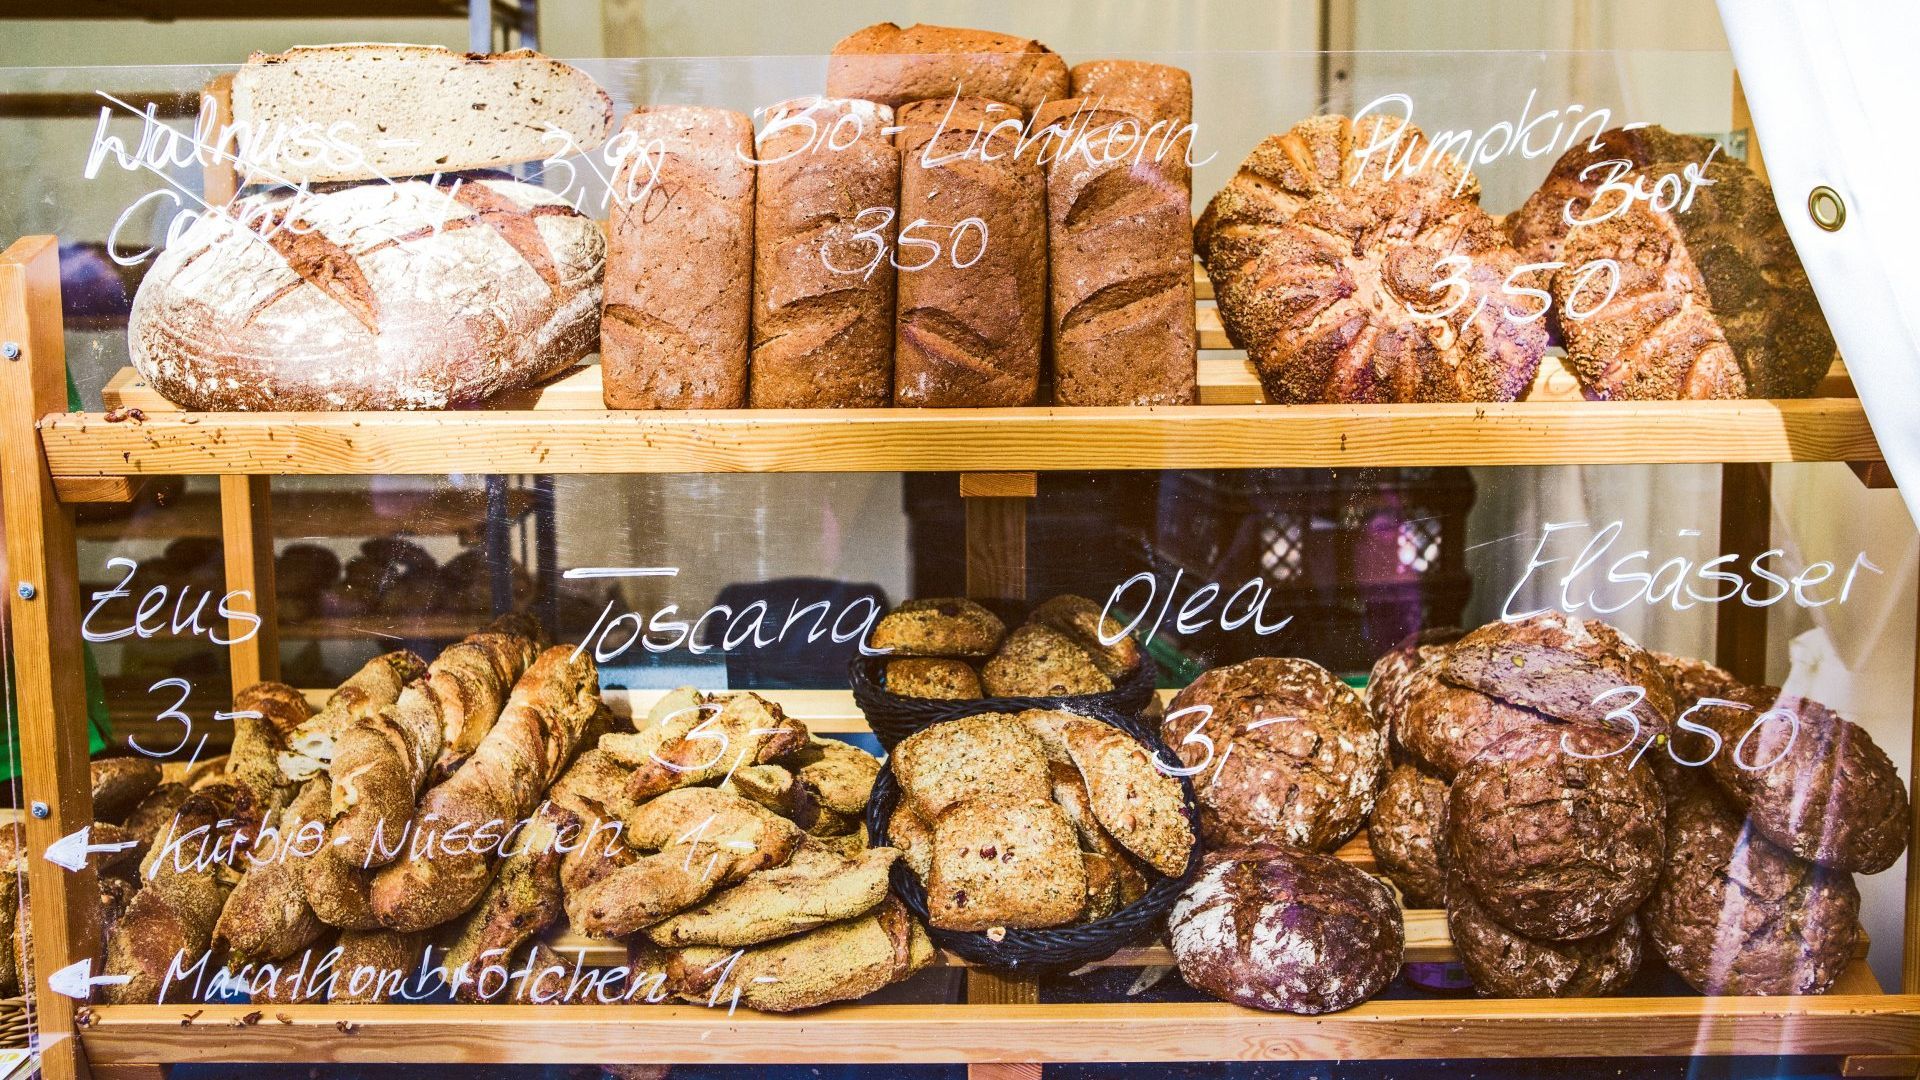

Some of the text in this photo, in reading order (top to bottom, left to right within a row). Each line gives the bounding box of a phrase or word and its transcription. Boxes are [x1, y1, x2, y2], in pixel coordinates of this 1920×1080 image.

[1350, 88, 1650, 197] Pumpkin-
[1563, 141, 1721, 227] Brot
[820, 206, 989, 282] 3,50
[1406, 255, 1621, 331] 3,50
[81, 557, 262, 645] Zeus
[1097, 569, 1294, 647] Olea
[1500, 520, 1884, 625] Elsässer
[563, 567, 894, 664] Toscana
[1560, 686, 1801, 771] 3,50
[158, 944, 669, 1005] Marathonbrötchen
